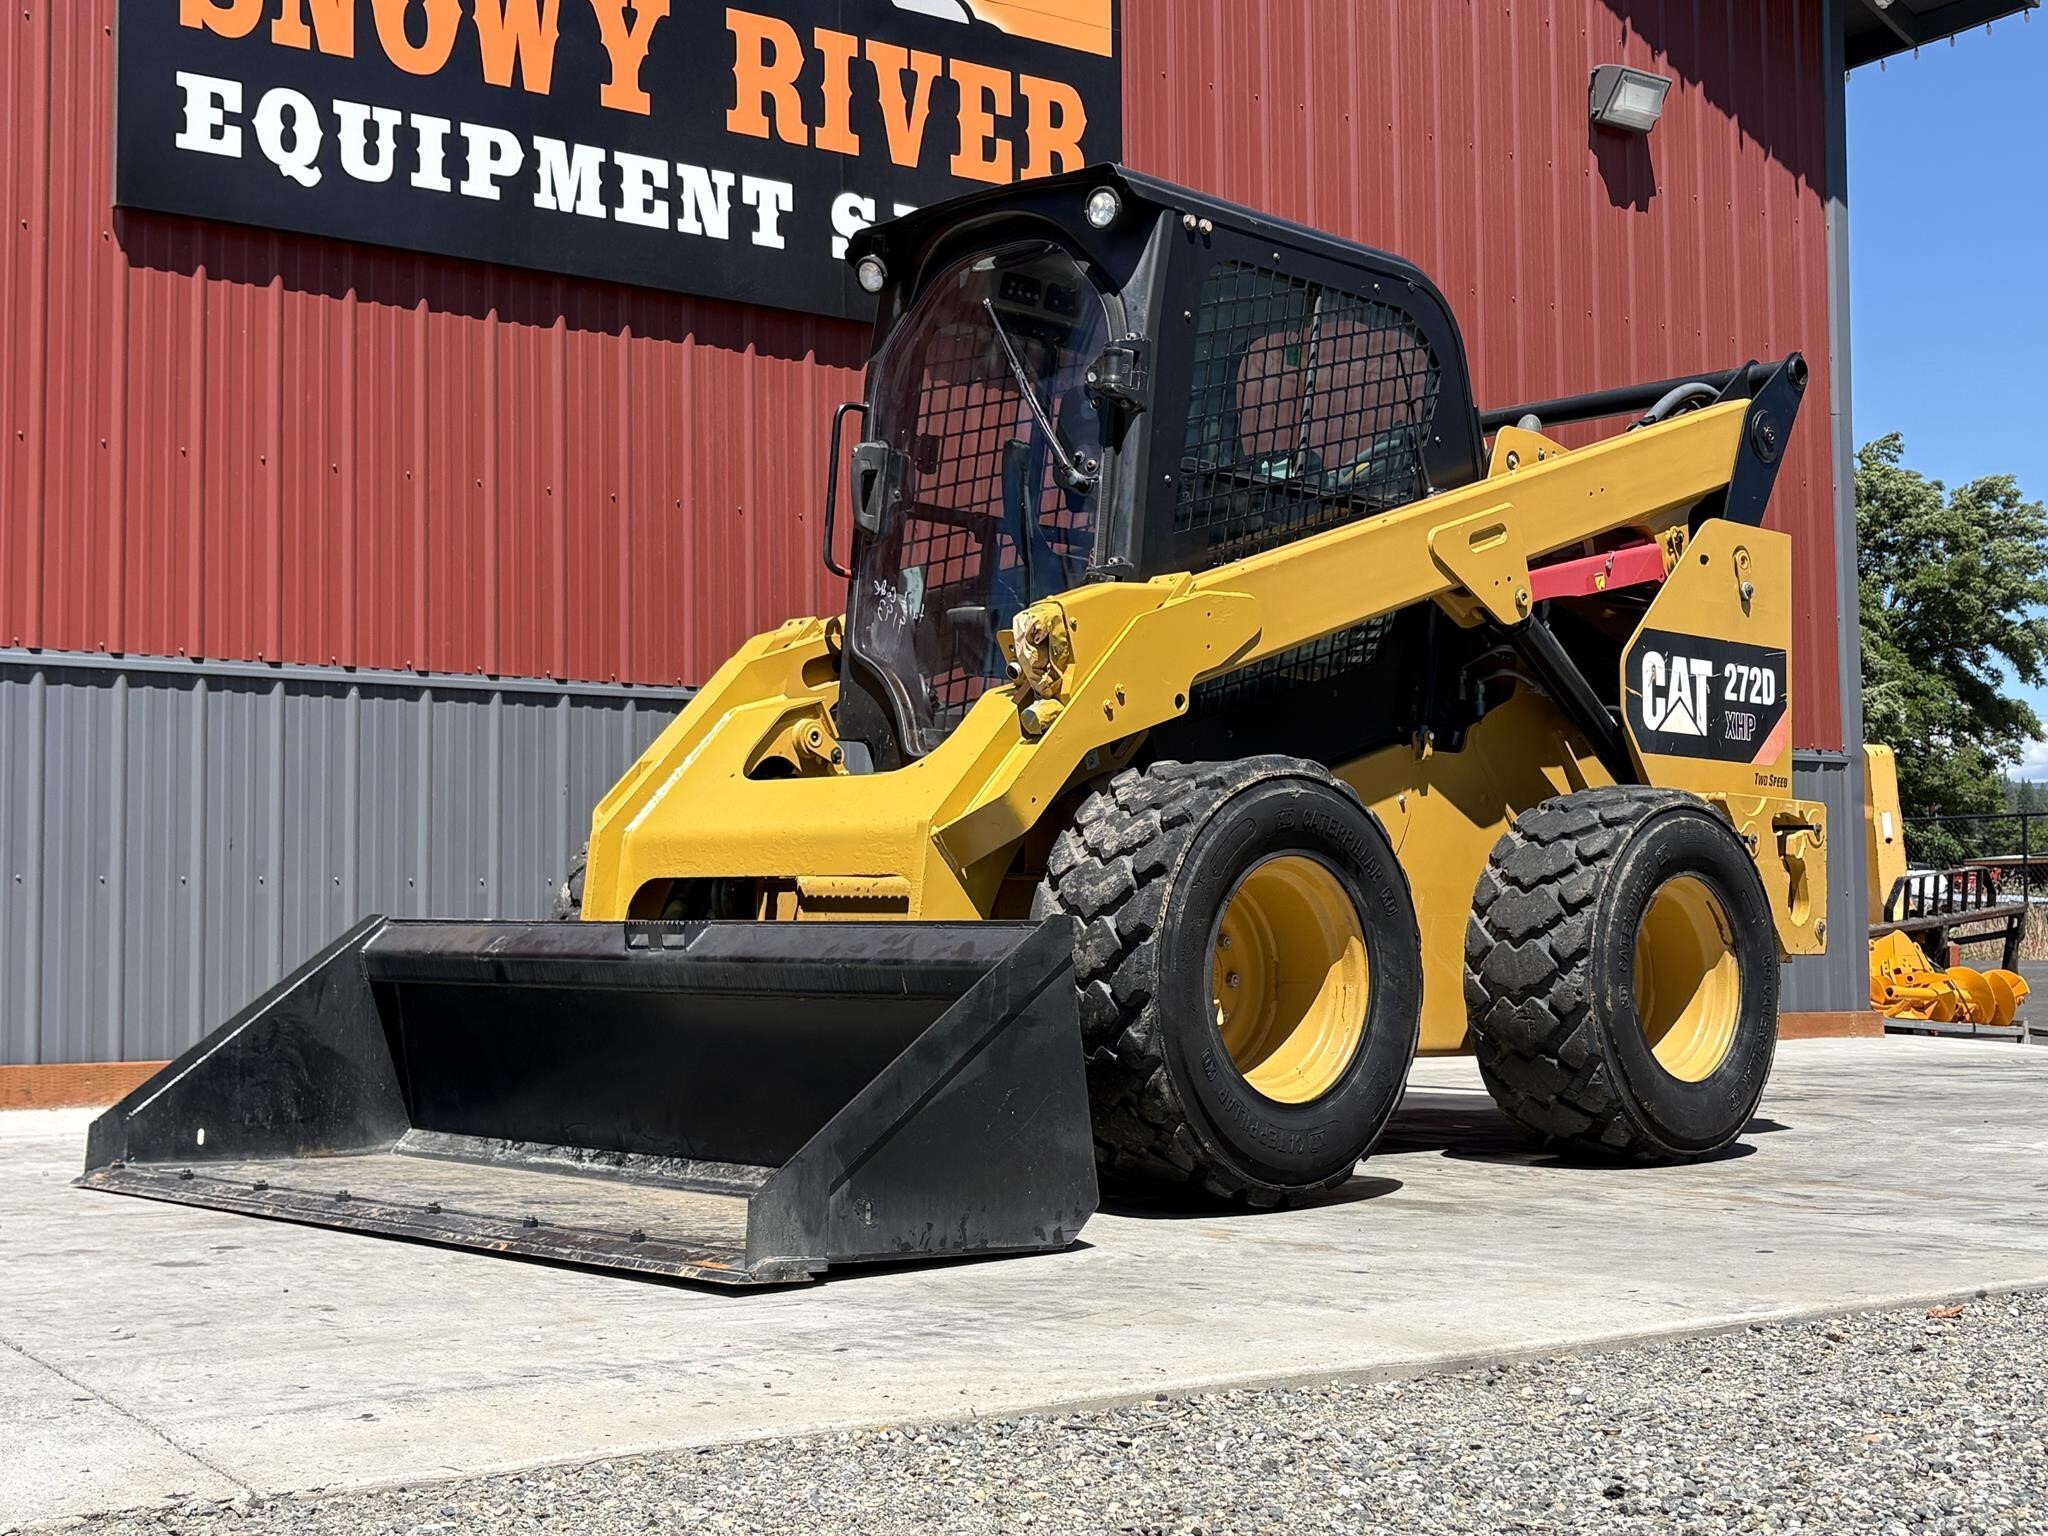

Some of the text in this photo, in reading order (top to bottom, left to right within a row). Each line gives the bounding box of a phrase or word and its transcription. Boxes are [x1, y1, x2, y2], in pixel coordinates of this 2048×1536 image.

[179, 0, 1088, 185] OWY RIVER
[175, 70, 793, 250] EQUIPMENT
[1642, 651, 1776, 737] CAT 272D
[1725, 711, 1757, 741] XHP
[1302, 808, 1384, 882] CATERPILLAR
